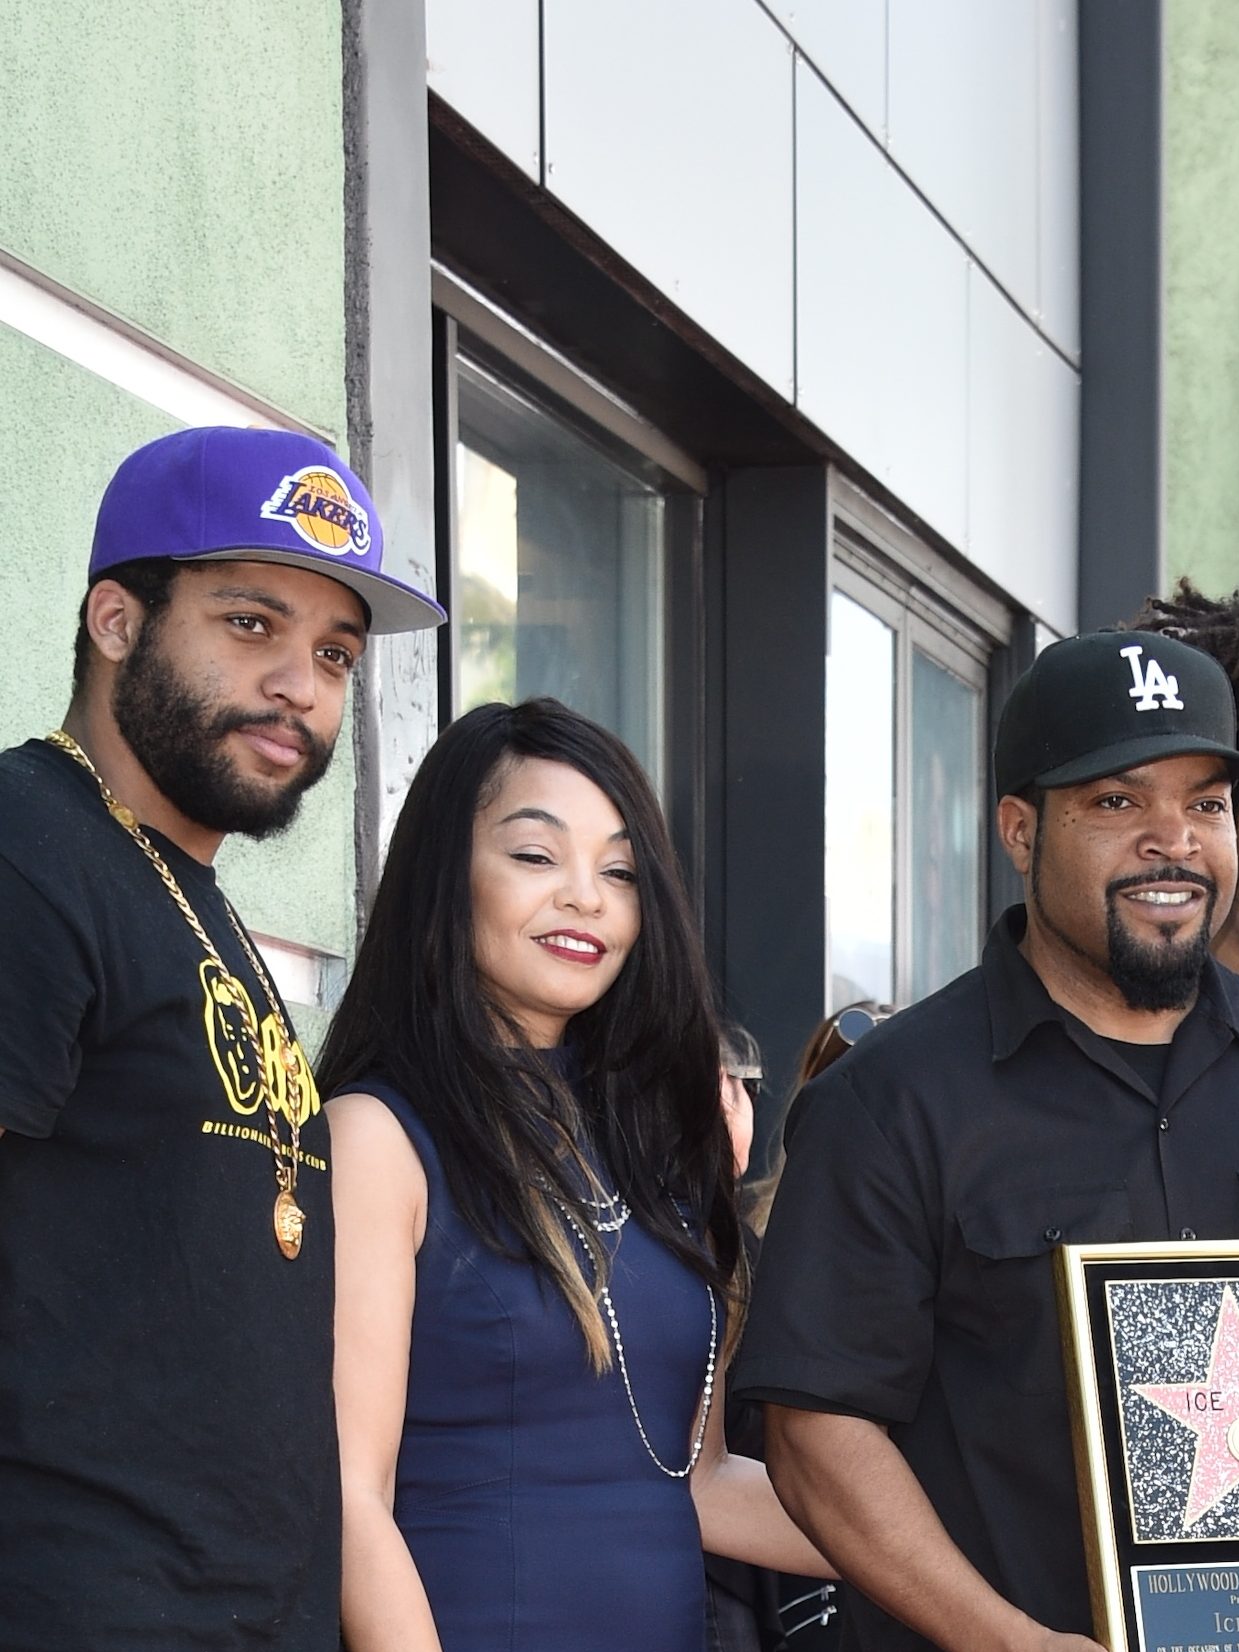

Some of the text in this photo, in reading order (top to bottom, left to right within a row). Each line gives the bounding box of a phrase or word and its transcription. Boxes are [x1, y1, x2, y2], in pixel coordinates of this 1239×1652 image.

[270, 481, 369, 550] LAKERS
[1120, 645, 1184, 711] LA
[201, 1120, 272, 1149] BILLIONAI
[281, 1143, 304, 1163] BOS
[1186, 1391, 1224, 1412] ICE
[1148, 1572, 1239, 1594] HOLLYWOOD
